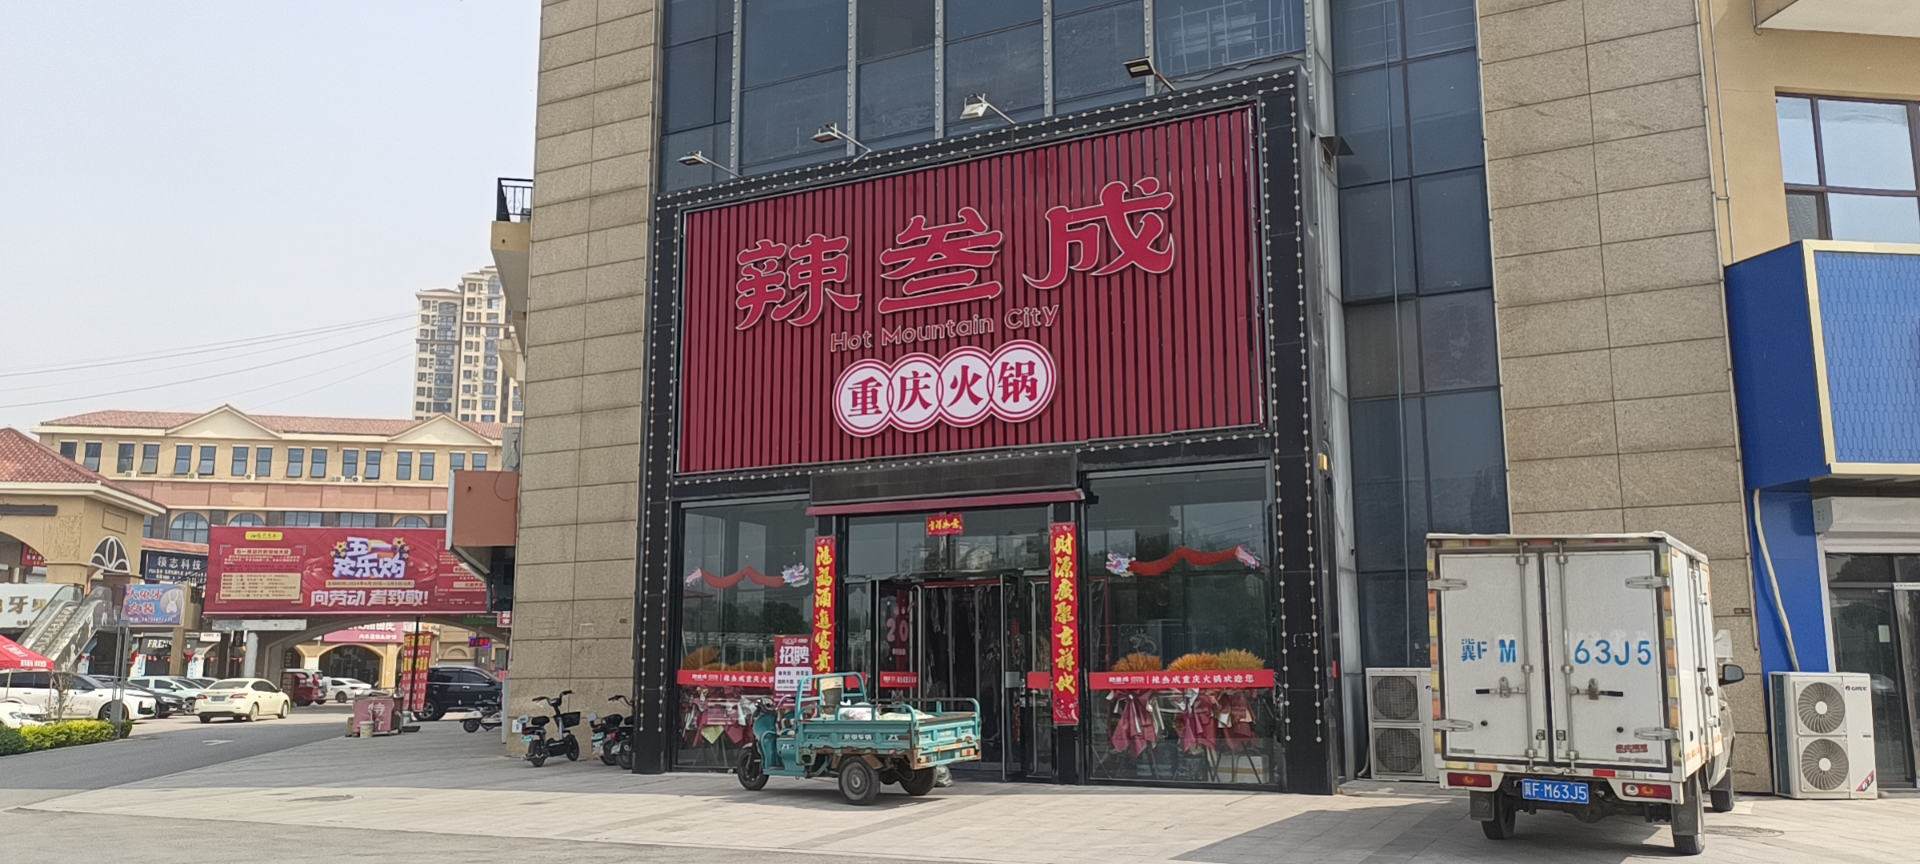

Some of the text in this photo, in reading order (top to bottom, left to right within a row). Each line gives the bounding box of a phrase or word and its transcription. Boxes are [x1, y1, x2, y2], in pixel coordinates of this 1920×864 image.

[736, 177, 1175, 331] 辣叁成
[830, 304, 1060, 353] Hot Mountain City
[847, 359, 1039, 418] 重庆火锅
[928, 517, 961, 531] 吉祥如意
[332, 553, 406, 579] 欢乐购
[779, 645, 810, 664] 招聘
[1498, 639, 1517, 663] M
[1574, 640, 1652, 666] 63J5
